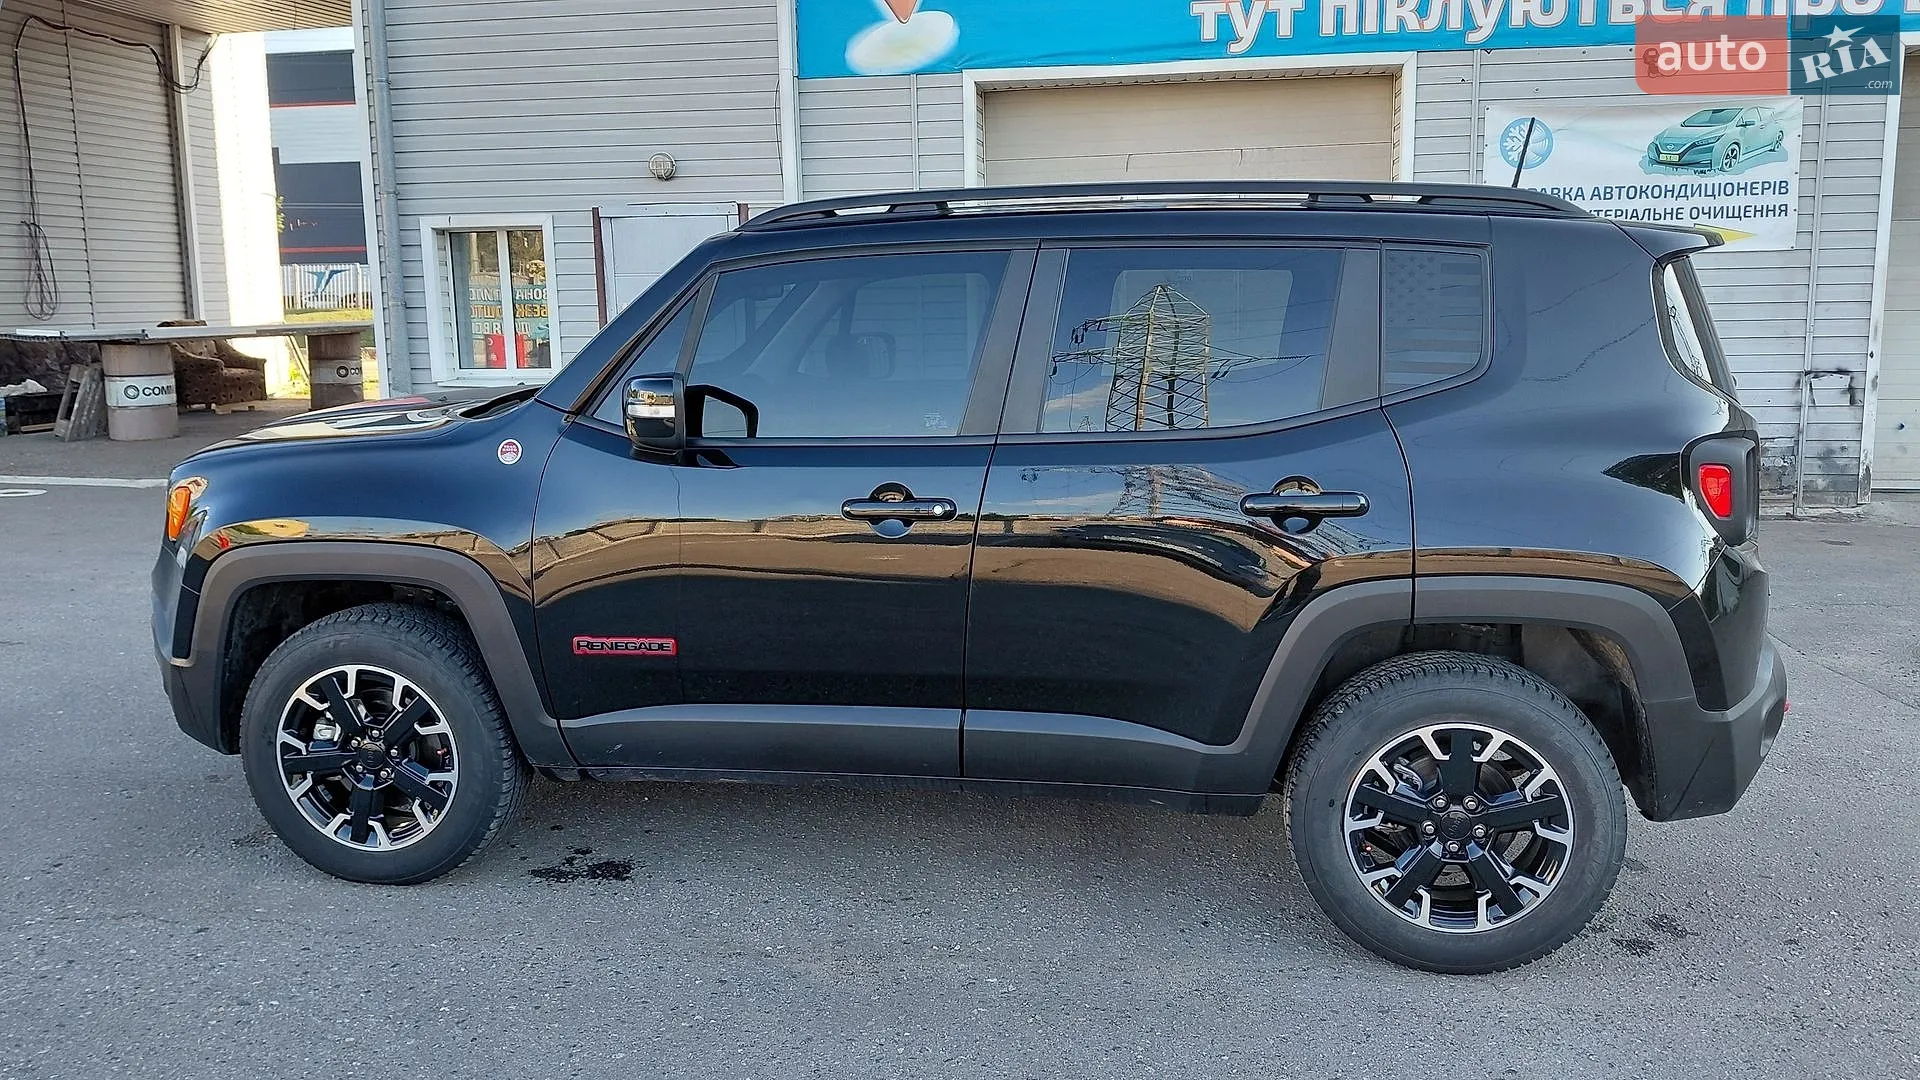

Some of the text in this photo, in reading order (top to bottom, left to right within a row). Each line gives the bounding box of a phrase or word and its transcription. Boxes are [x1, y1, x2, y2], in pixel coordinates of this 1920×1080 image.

[1190, 0, 1305, 55] тут
[1319, 0, 1726, 45] піклуються
[1590, 180, 1789, 201] АВТОКОНДИЦІОНЕРІВ
[1588, 204, 1789, 222] ТЕРІАЛЬНЕ ОЧИЩЕННЯ
[575, 639, 673, 653] RENEGADE
